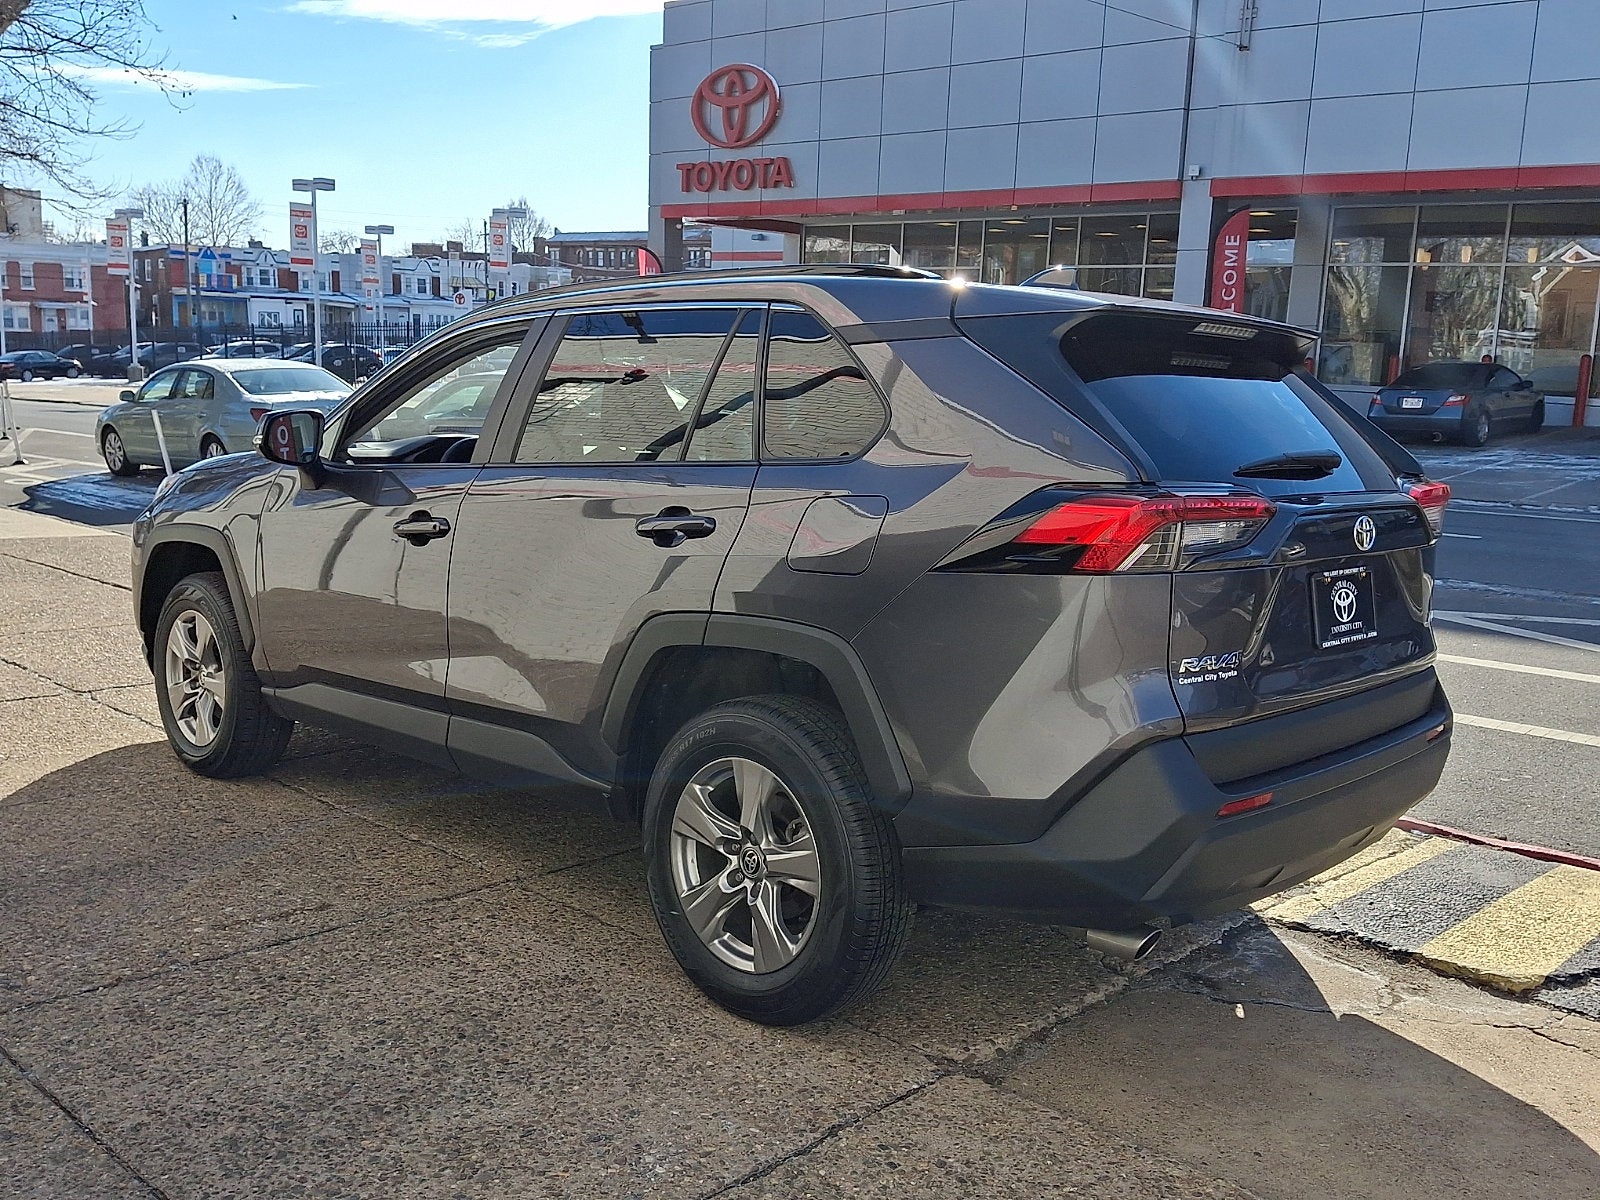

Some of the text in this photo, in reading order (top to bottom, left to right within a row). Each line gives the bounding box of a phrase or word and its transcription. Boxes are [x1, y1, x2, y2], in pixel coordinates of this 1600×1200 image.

[676, 156, 794, 193] TOYOTA
[1347, 581, 1359, 596] CITY
[1352, 621, 1363, 630] CITY
[1322, 639, 1340, 648] CENTRAL
[1341, 636, 1350, 644] CITY
[1178, 650, 1240, 674] RAV4
[1178, 669, 1238, 685] Central City Toyota
